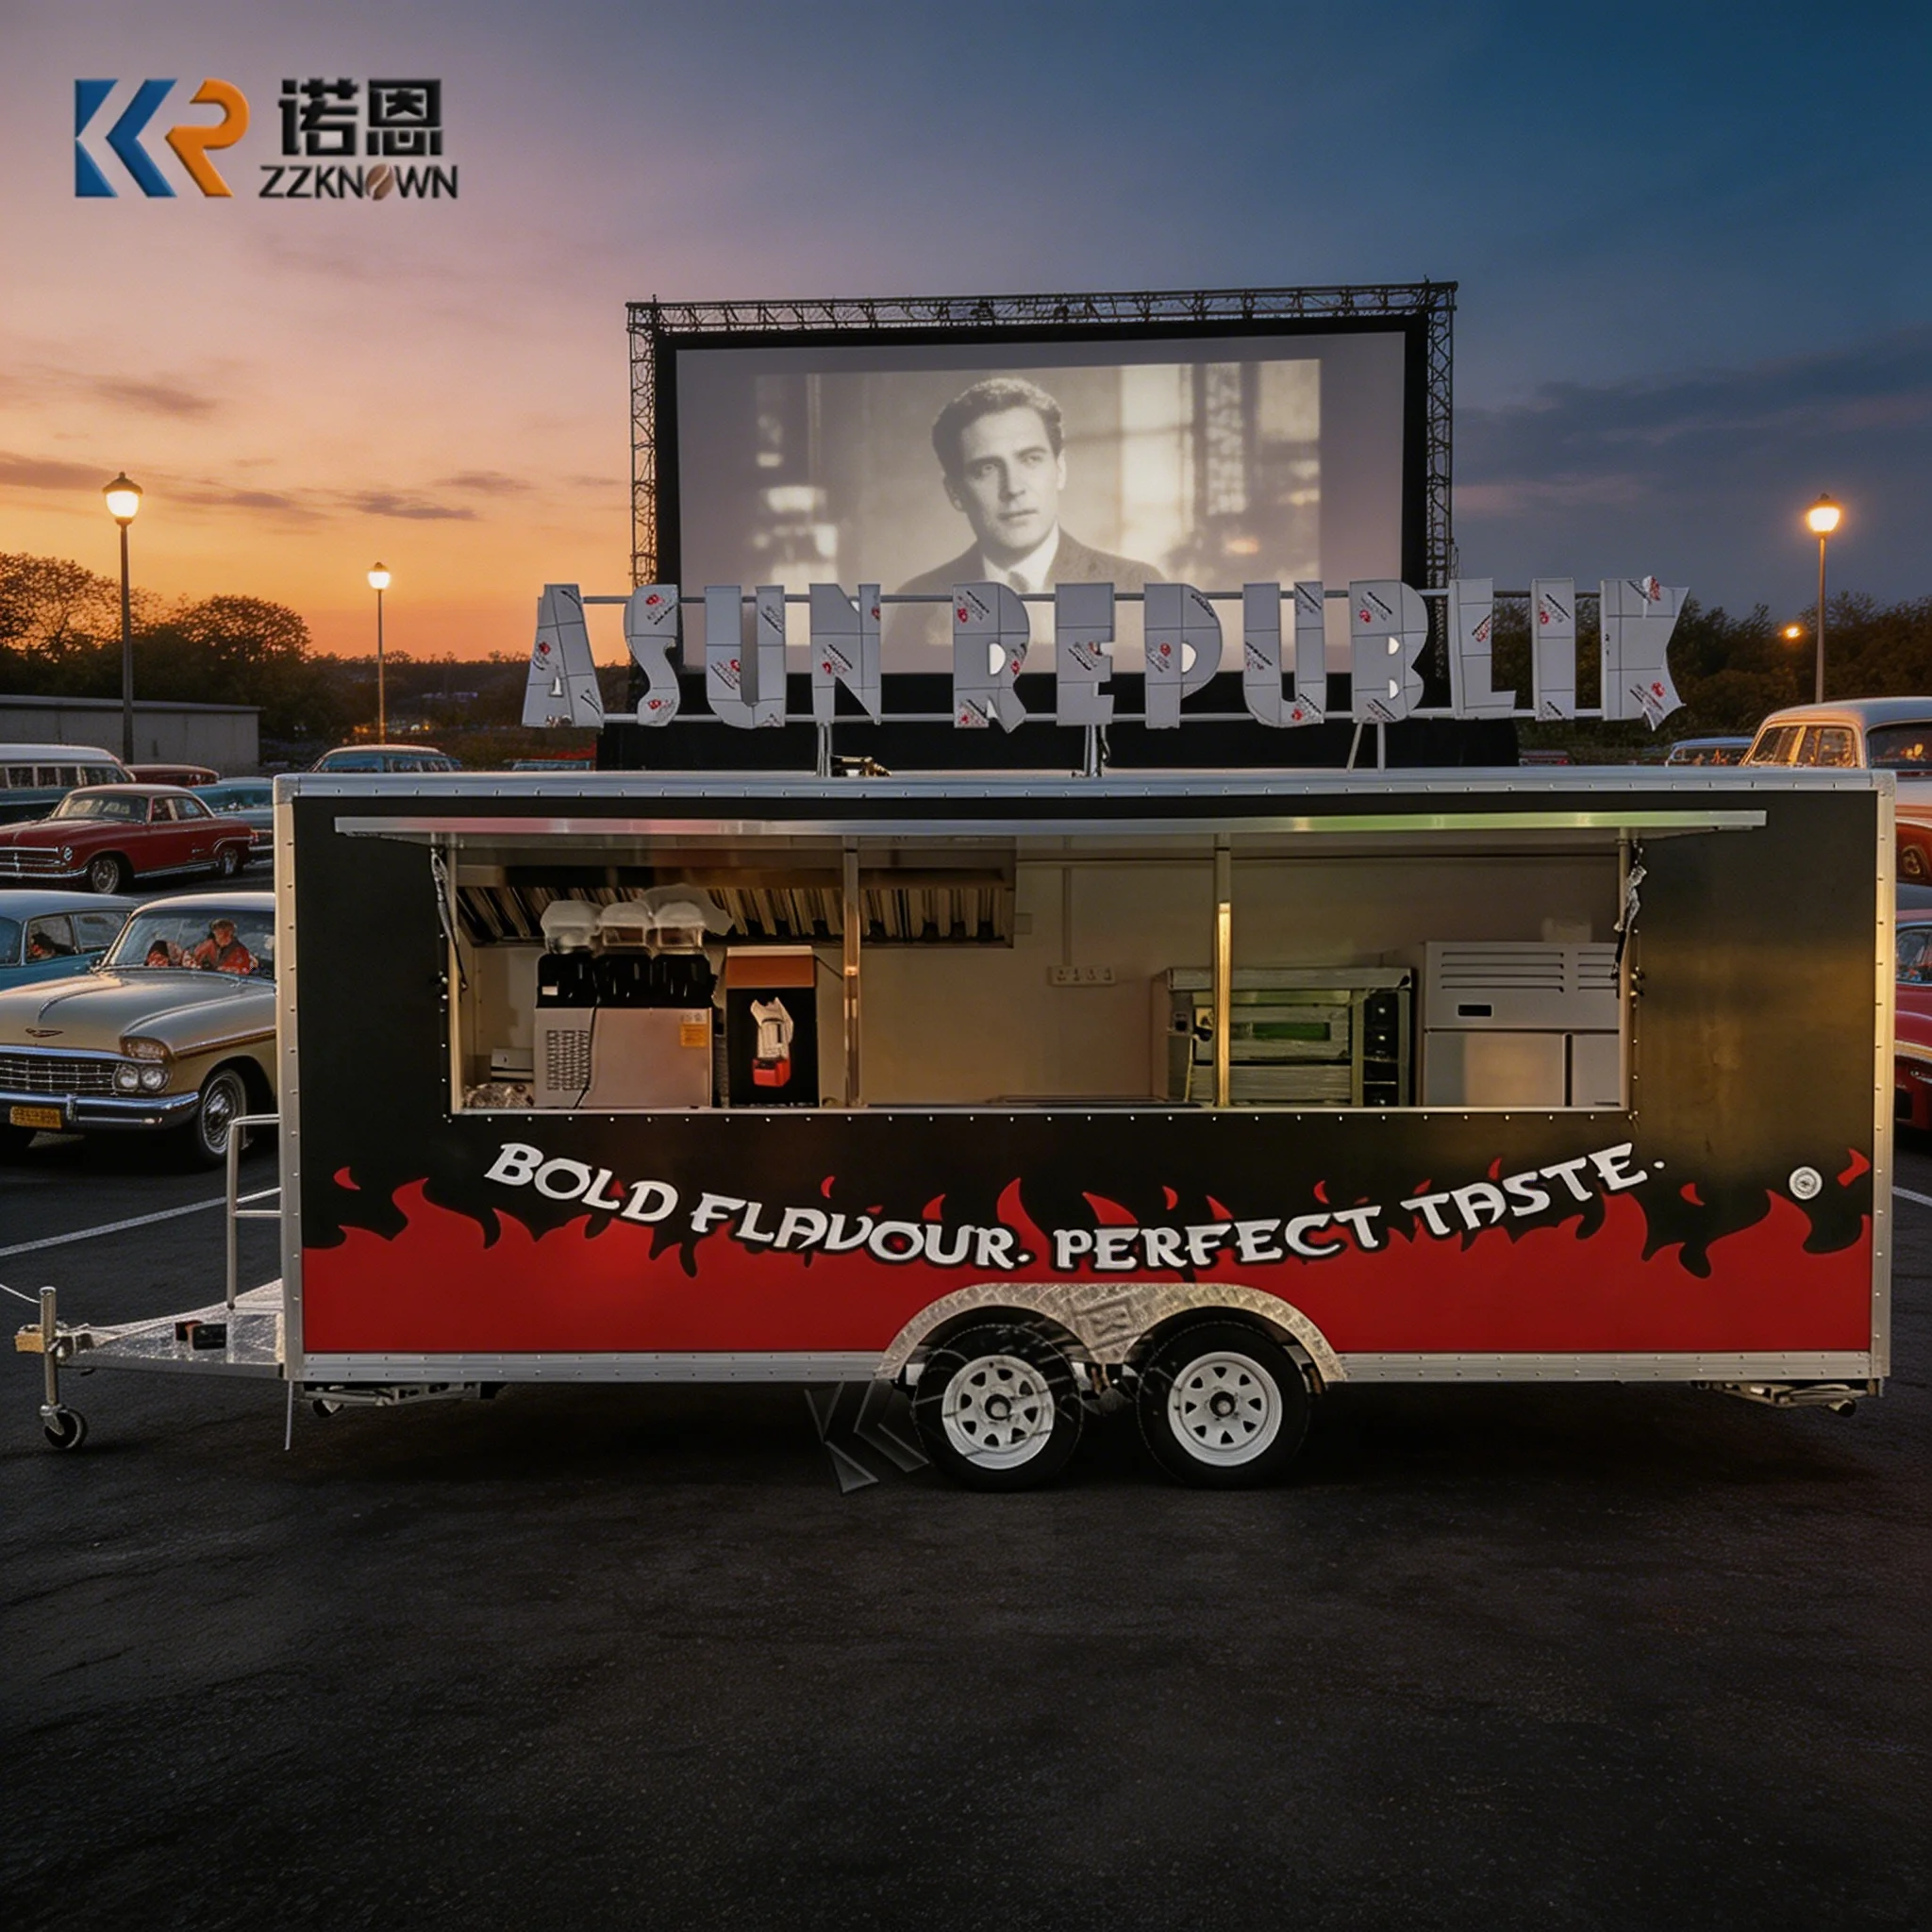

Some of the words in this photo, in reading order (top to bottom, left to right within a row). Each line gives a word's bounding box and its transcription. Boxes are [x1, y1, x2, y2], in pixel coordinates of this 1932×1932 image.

[953, 575, 1690, 733] REPUBLIK
[484, 1143, 678, 1222] BOLD
[691, 1192, 1036, 1269] FLAVOUR.
[1054, 1205, 1382, 1270] PERFECT
[1401, 1142, 1665, 1236] TASTE.
